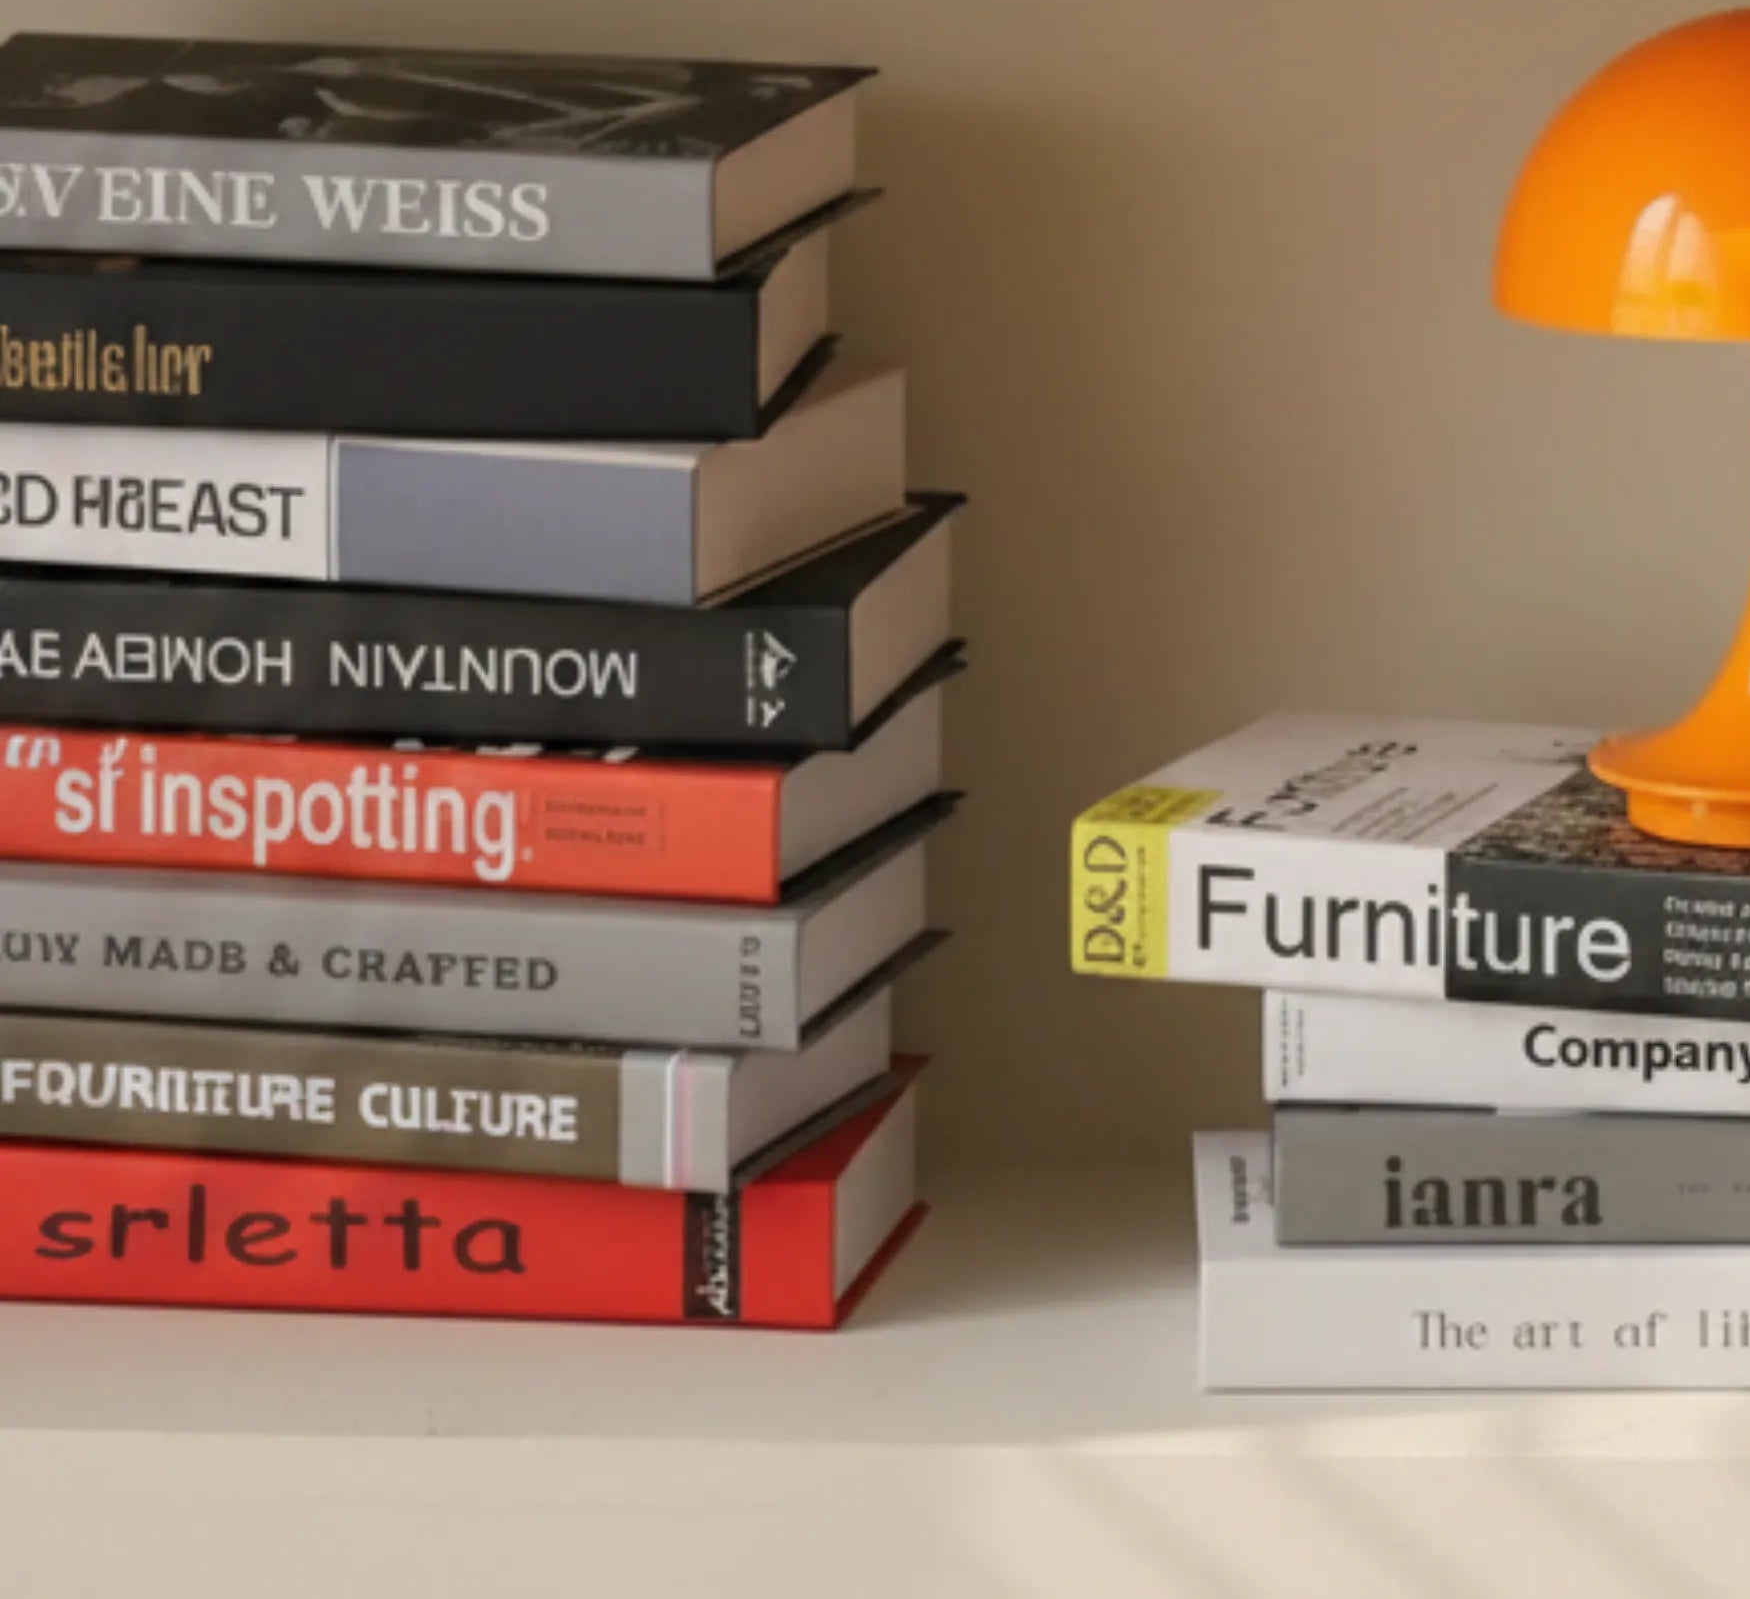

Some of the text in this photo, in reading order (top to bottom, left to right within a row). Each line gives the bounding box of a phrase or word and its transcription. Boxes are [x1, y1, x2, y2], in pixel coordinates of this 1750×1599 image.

[303, 175, 551, 241] WEISS
[1083, 835, 1128, 962] D&D
[1196, 864, 1632, 983] Furniture
[266, 943, 300, 976] &
[1383, 1158, 1603, 1229] ianra
[35, 1185, 526, 1276] srletta
[1415, 1310, 1488, 1350] The
[1512, 1320, 1583, 1350] art
